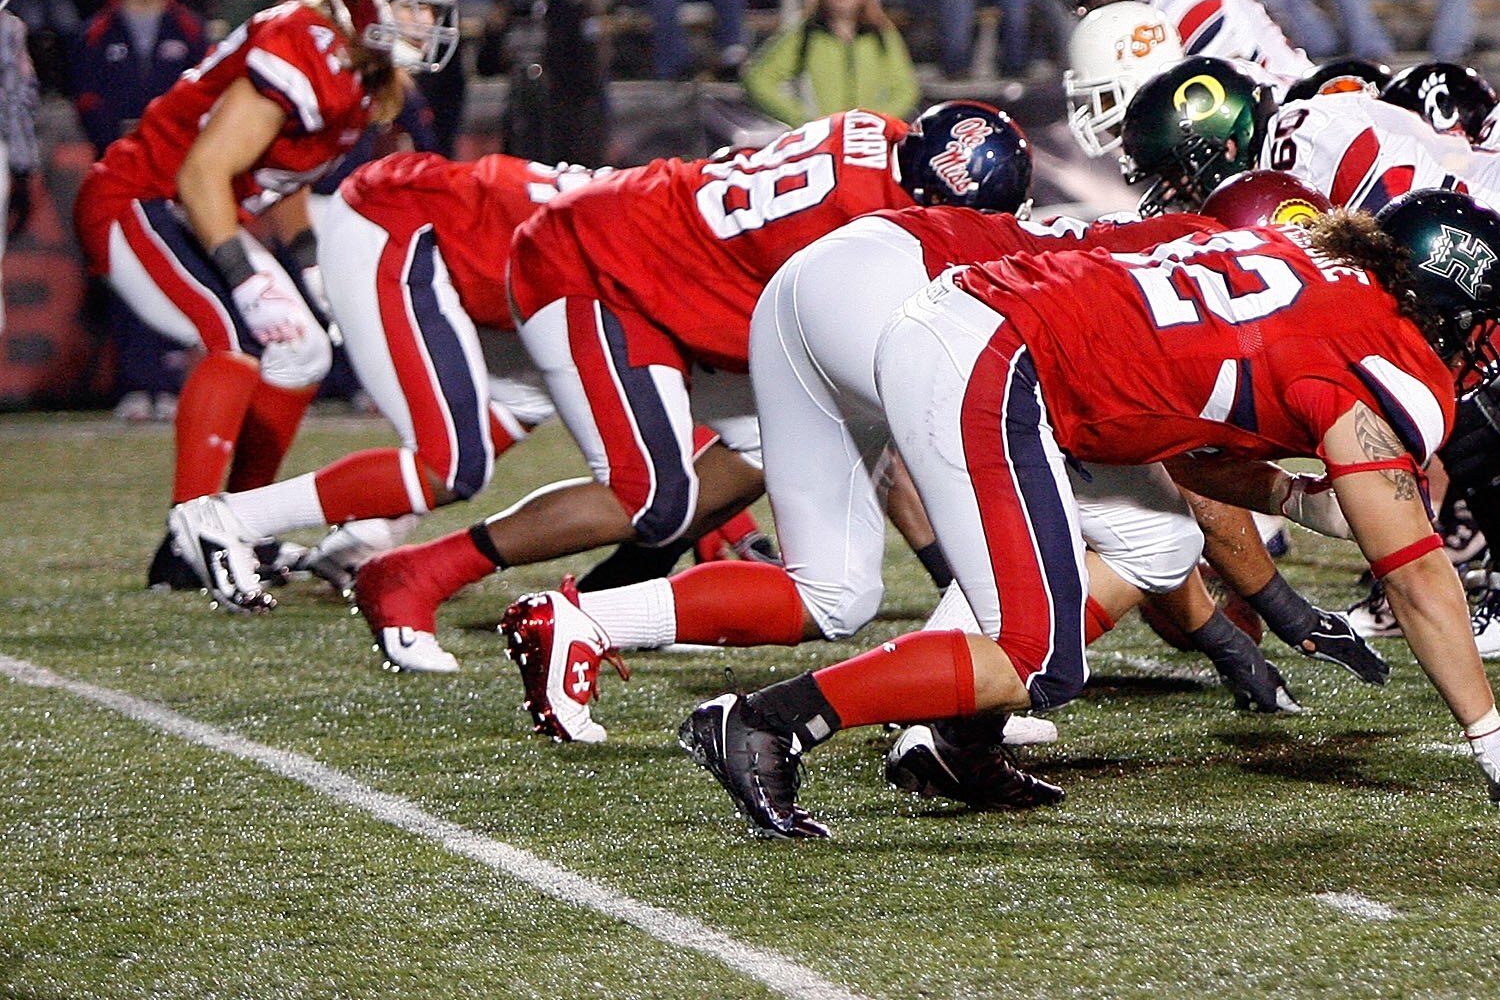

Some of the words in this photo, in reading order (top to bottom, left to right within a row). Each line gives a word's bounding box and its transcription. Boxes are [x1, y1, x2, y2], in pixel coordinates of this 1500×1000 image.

[1173, 74, 1227, 121] O
[1424, 83, 1460, 130] C
[950, 117, 993, 149] Ole
[929, 141, 974, 196] Miss
[1418, 224, 1498, 300] H
